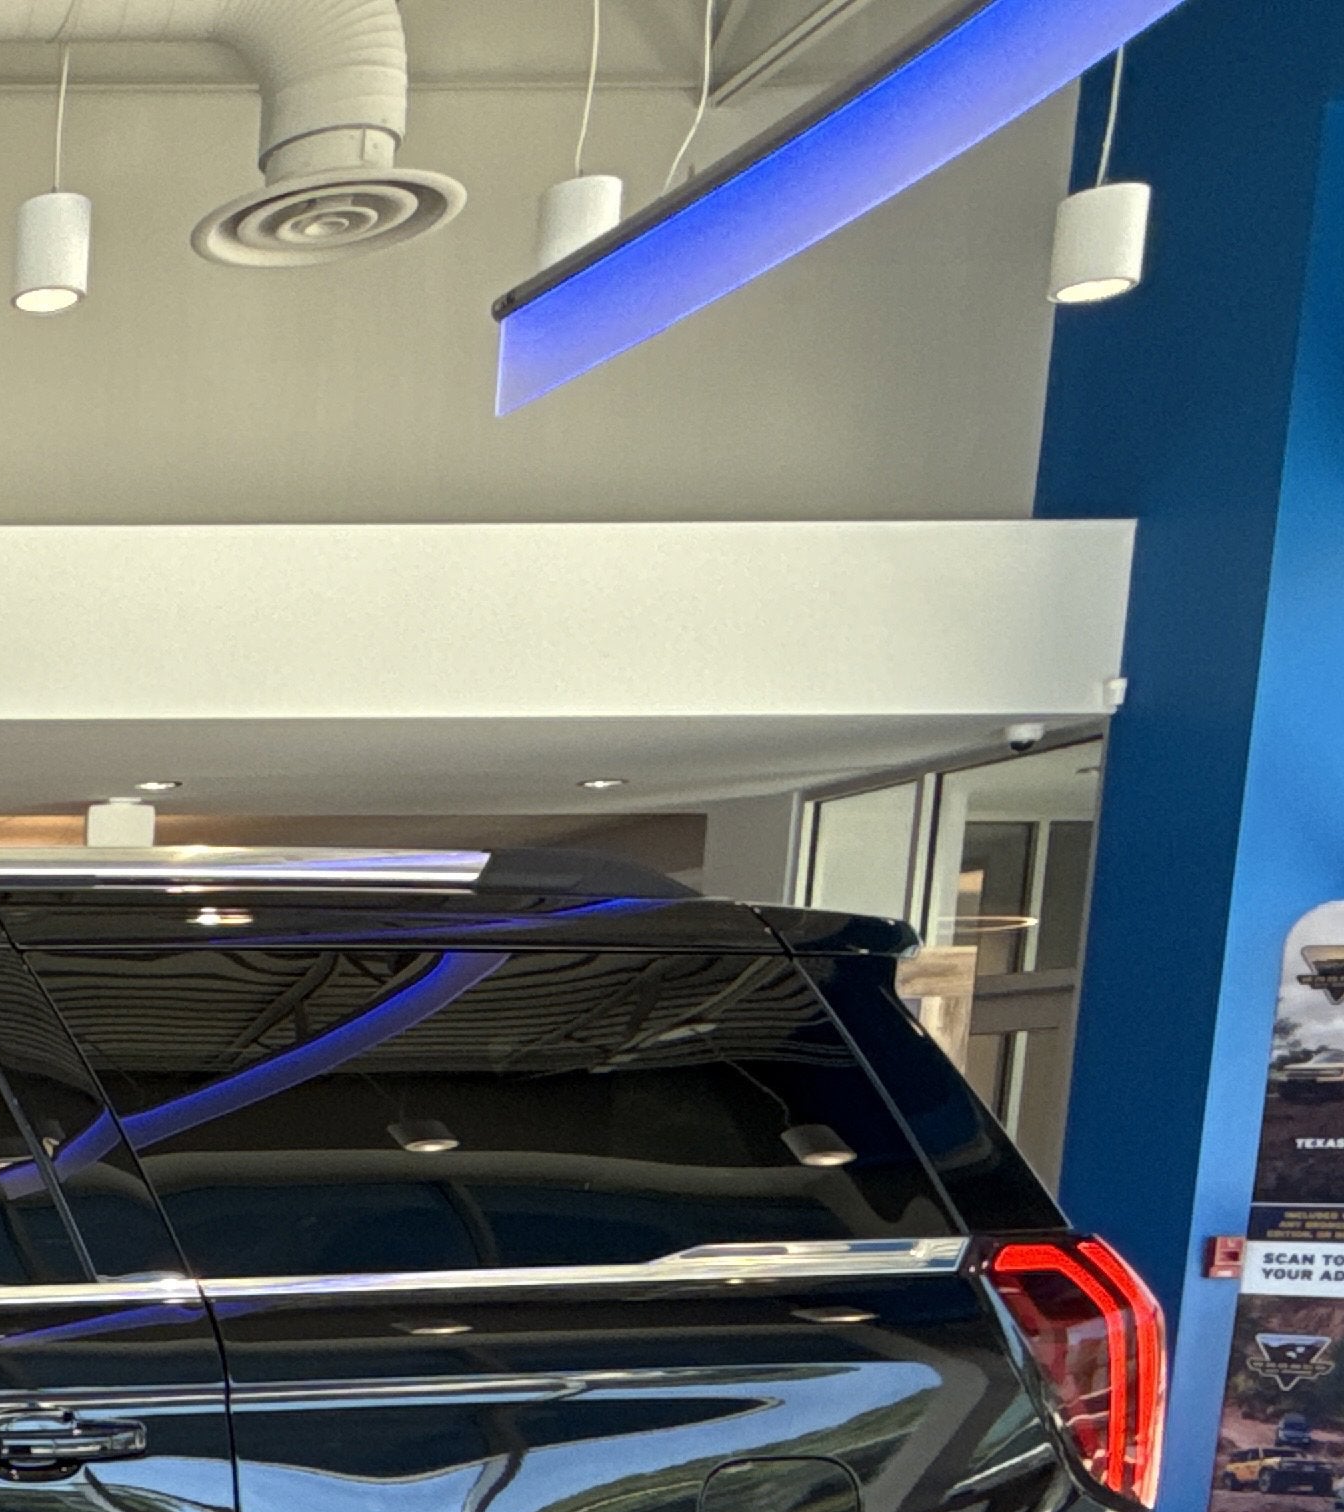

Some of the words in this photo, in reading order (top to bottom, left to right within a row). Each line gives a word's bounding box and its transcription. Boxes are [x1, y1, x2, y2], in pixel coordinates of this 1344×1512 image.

[1263, 1252, 1316, 1265] SCAN
[1322, 1254, 1344, 1266] TO
[1261, 1268, 1313, 1281] YOUR
